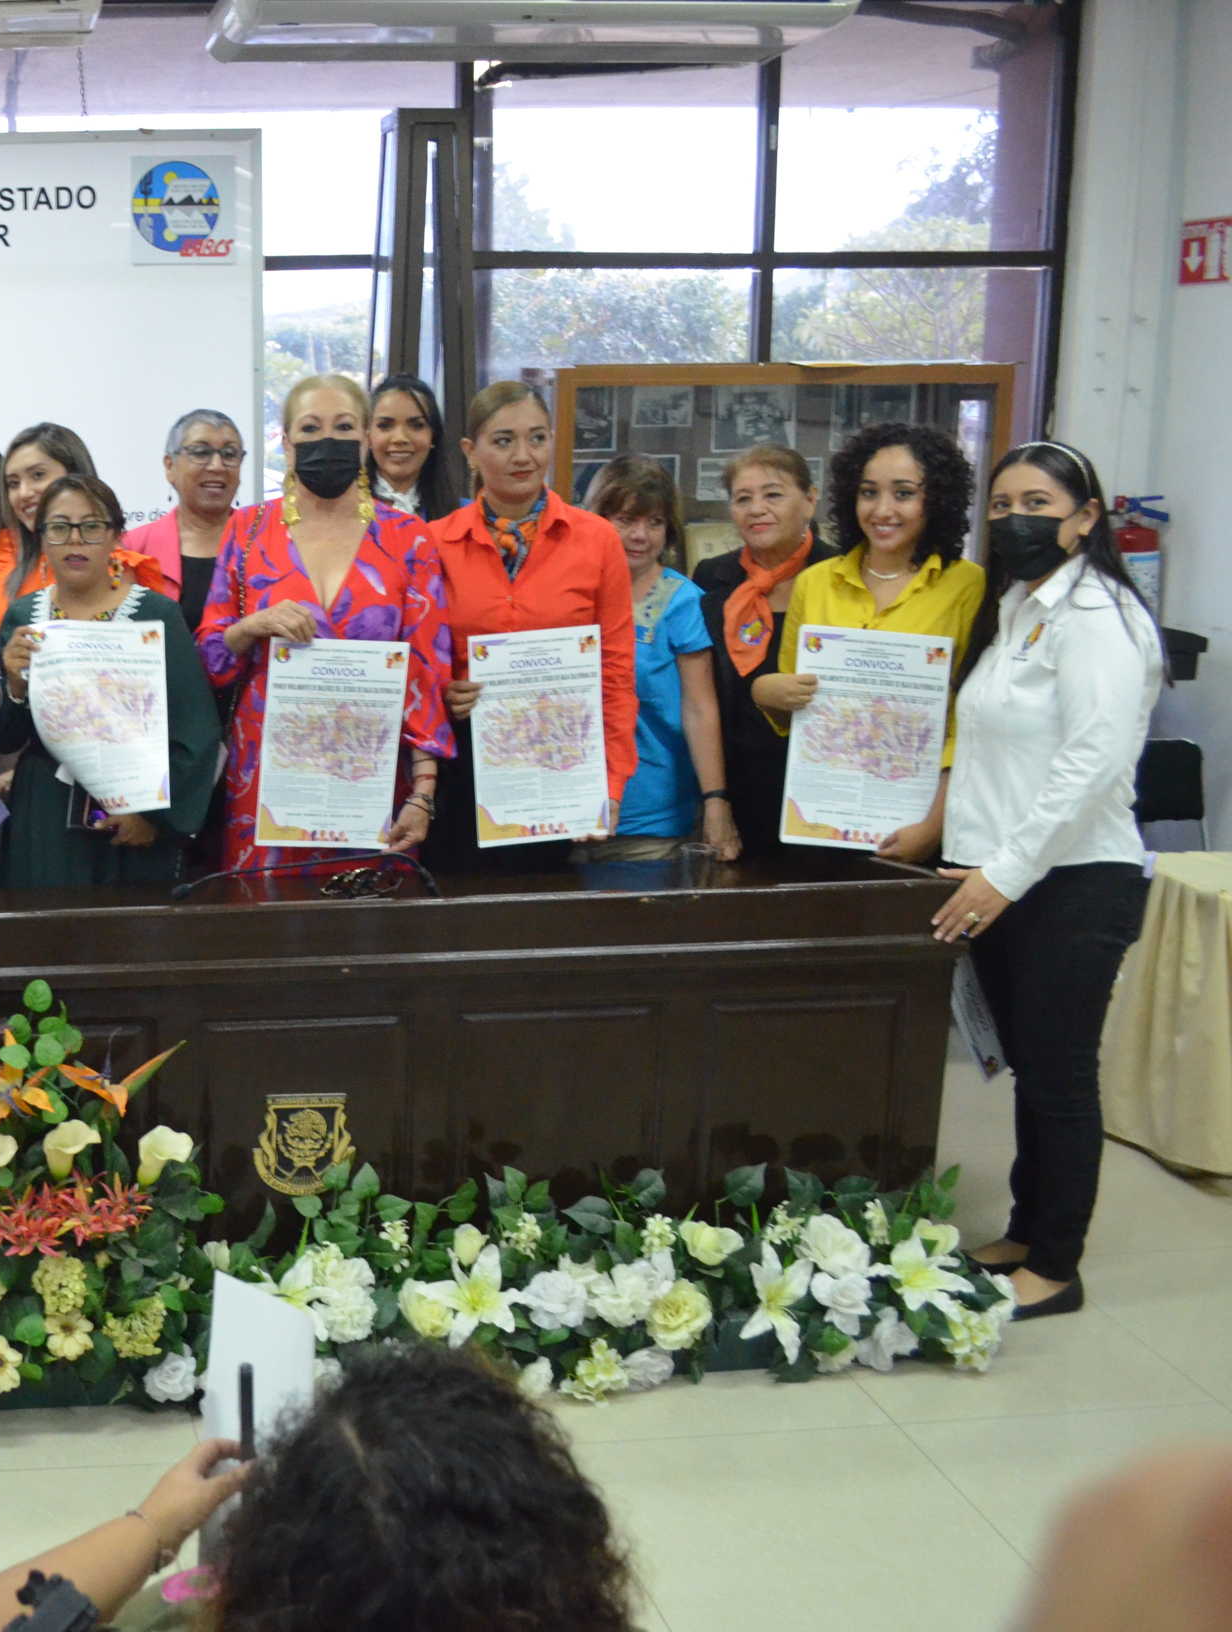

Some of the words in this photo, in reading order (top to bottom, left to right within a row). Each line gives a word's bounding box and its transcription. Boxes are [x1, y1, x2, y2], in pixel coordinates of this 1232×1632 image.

[510, 657, 563, 670] CONVOCA
[843, 657, 905, 671] CONVOCA
[311, 666, 368, 678] CONVOCA
